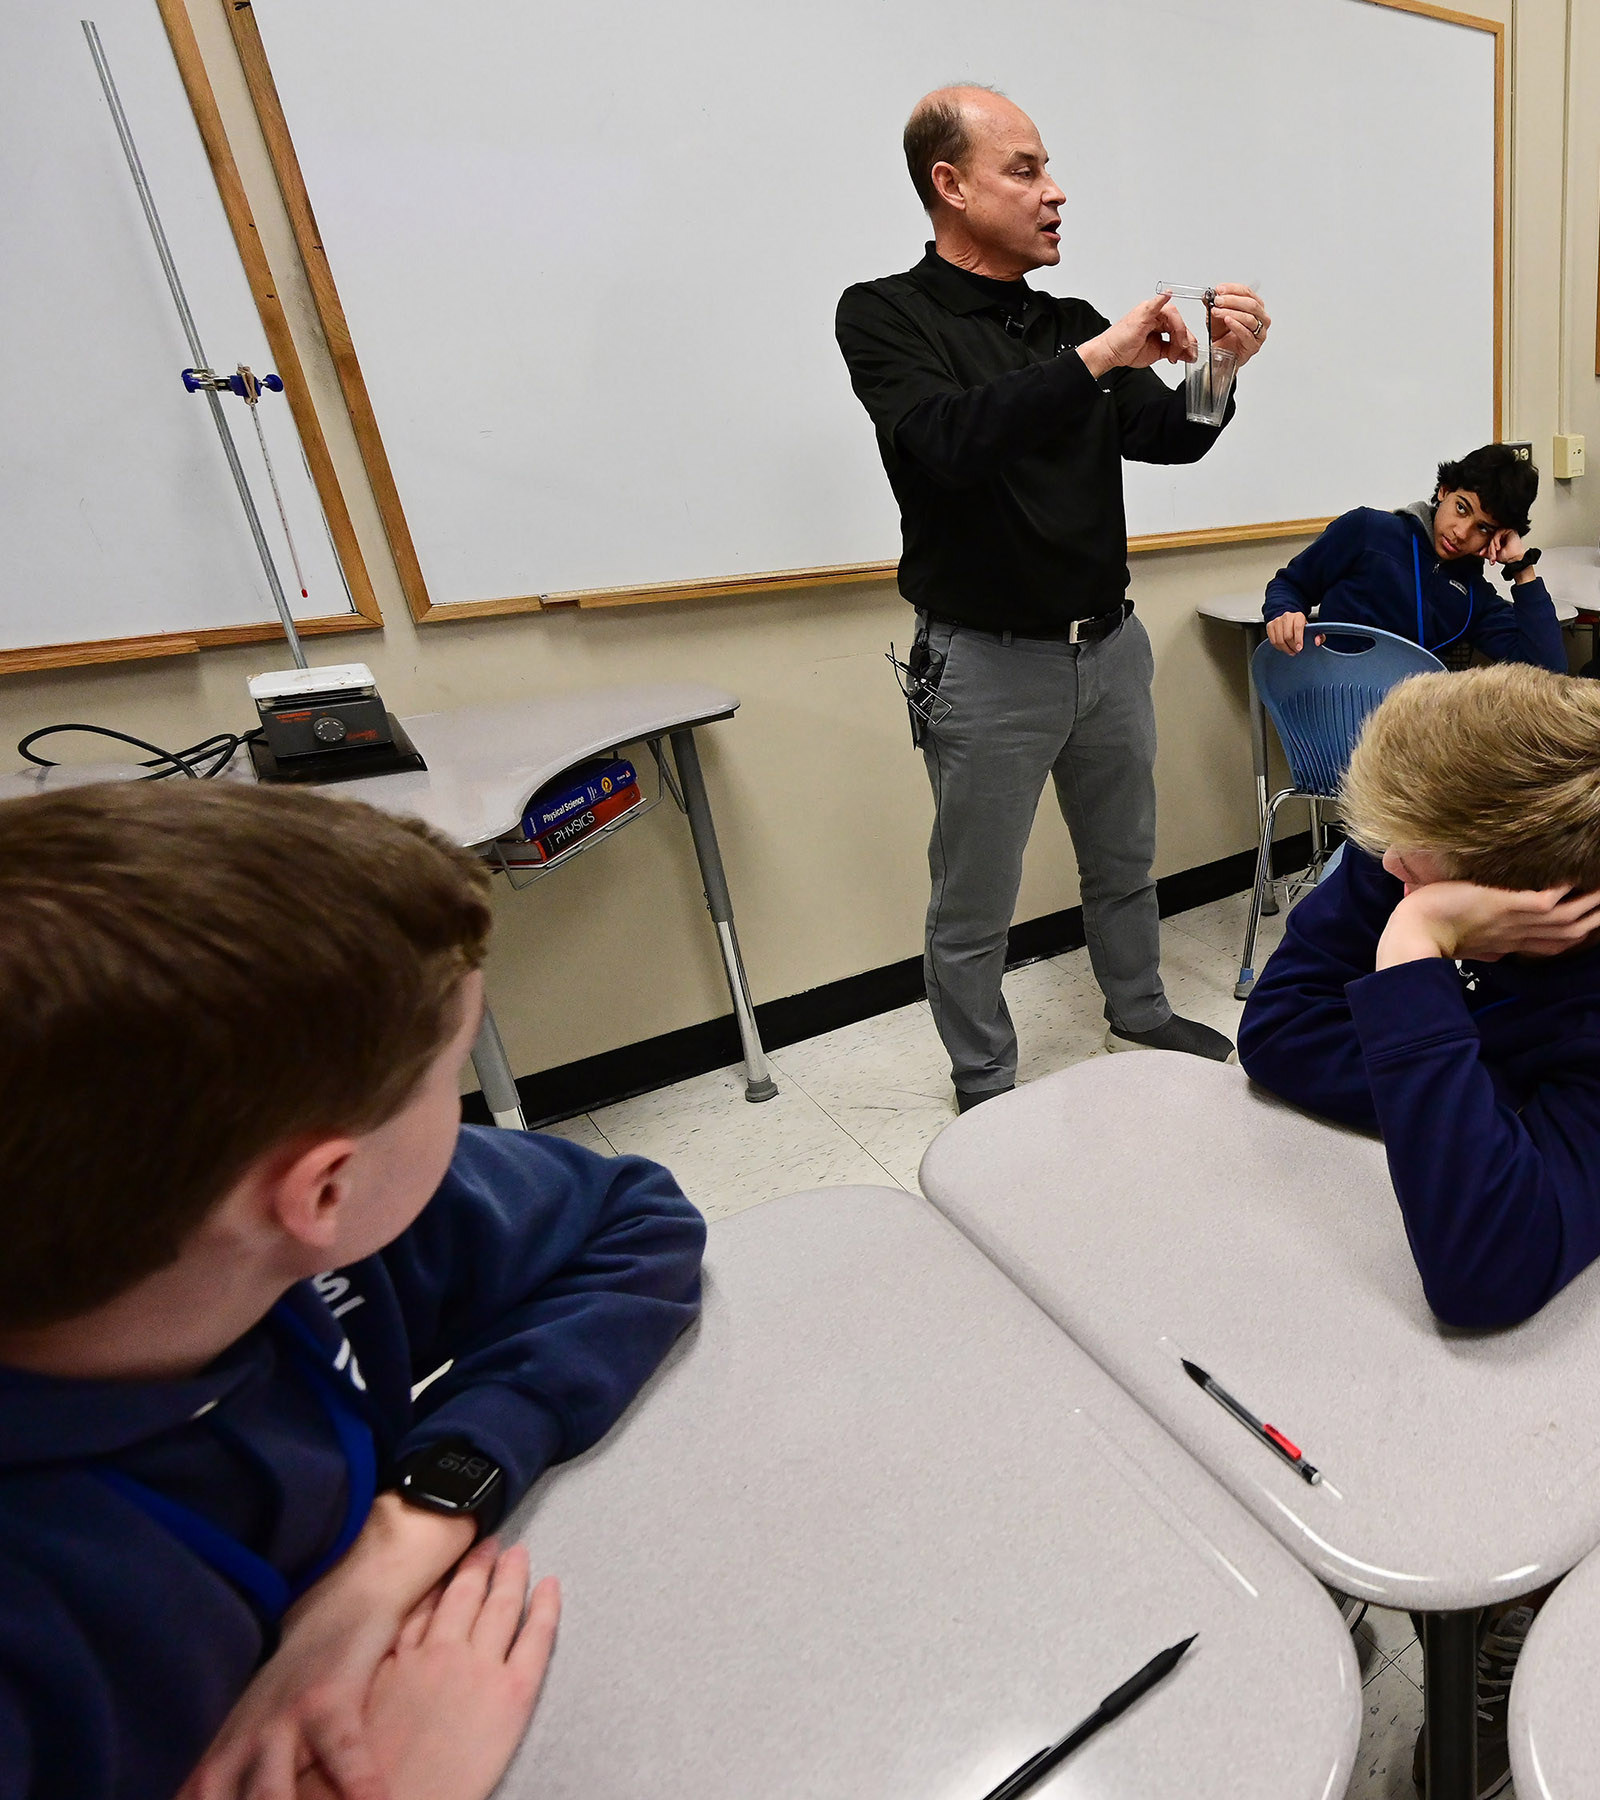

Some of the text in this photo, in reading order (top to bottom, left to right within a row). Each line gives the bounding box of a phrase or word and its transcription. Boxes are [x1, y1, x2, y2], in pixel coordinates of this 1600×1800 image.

[542, 795, 585, 824] Physical Science
[553, 811, 596, 845] PHYSICS
